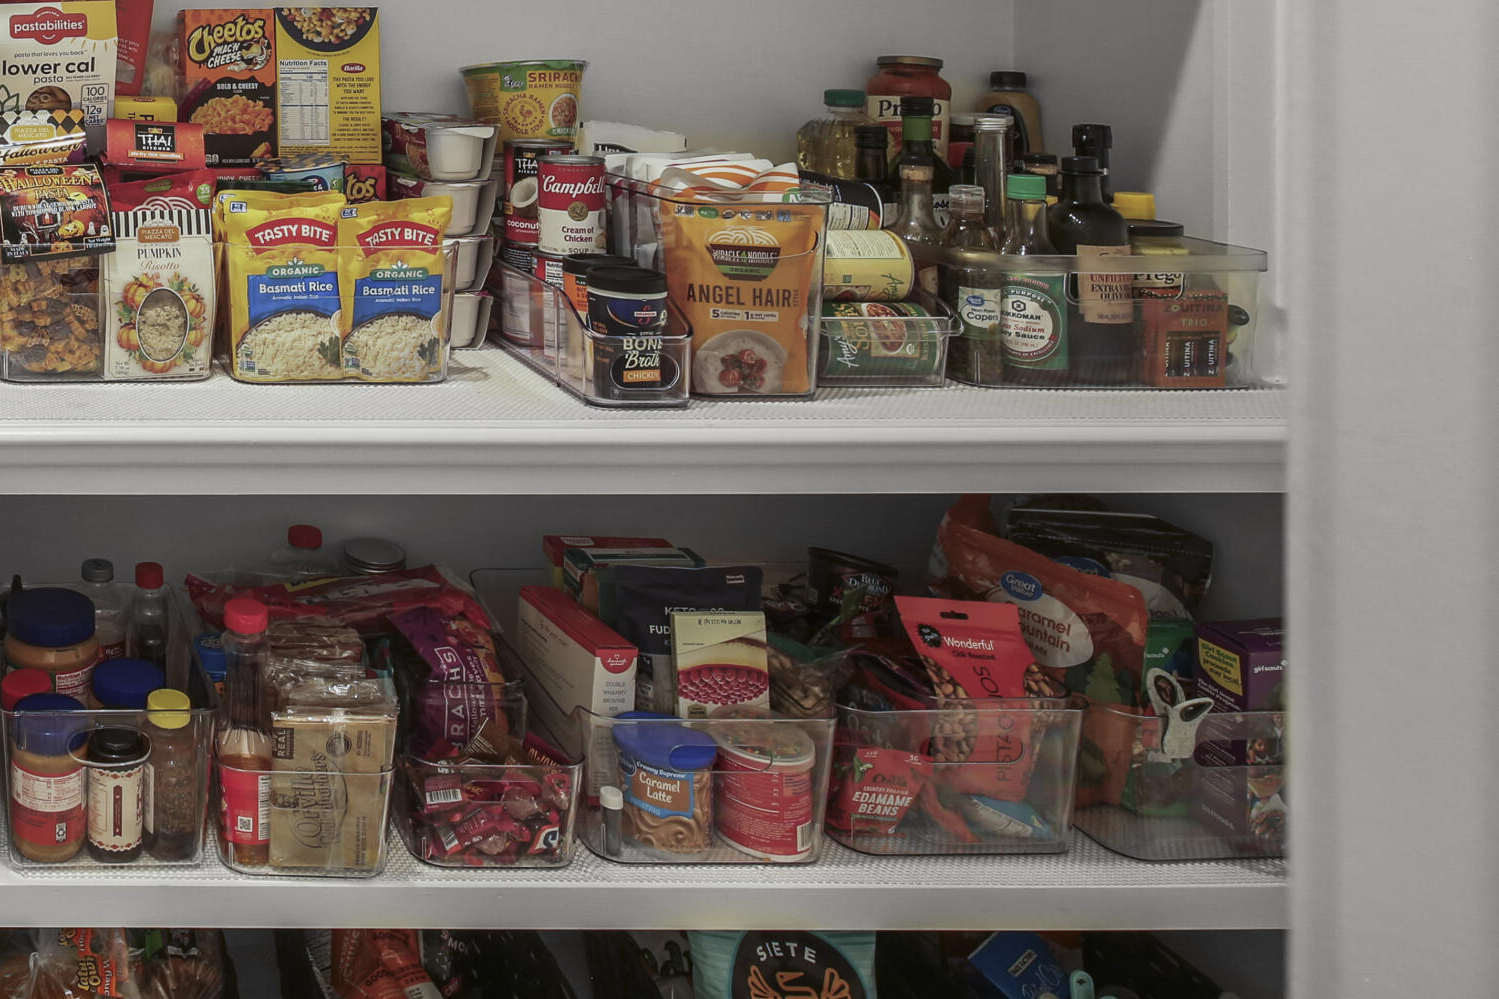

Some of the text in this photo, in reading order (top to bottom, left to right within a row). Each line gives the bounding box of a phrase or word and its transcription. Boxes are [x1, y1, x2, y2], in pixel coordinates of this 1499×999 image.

[14, 20, 83, 34] pastabilities
[189, 14, 266, 62] Cheetos
[214, 42, 239, 55] MAC'N
[2, 57, 95, 76] lower cal
[208, 52, 242, 68] CHEESE
[33, 75, 64, 85] pasta
[86, 86, 104, 96] 100
[85, 105, 102, 115] 12g
[137, 134, 172, 146] THAI
[1, 176, 93, 193] HALLOWEEN
[35, 187, 70, 200] PASTA
[254, 224, 331, 244] TASTY BITE
[561, 226, 585, 234] Cream
[365, 228, 436, 248] TASTY BITE
[564, 234, 593, 243] Chicken
[137, 248, 182, 260] PUMPKIN
[140, 261, 181, 271] Risotto
[272, 266, 320, 276] ORGANIC
[376, 270, 423, 279] ORGANIC
[259, 282, 334, 294] Basmati Rice
[362, 285, 435, 296] Basmati Rice
[686, 283, 791, 308] ANGEL HAIR
[712, 309, 719, 318] 5
[1014, 323, 1045, 333] Sodium
[1181, 318, 1208, 327] TRIO
[1015, 332, 1045, 340] Sauce
[1005, 574, 1036, 592] Great
[944, 636, 994, 650] Wonderful
[278, 730, 286, 757] REAL
[636, 761, 685, 779] Creamy Supreme
[639, 772, 680, 793] Caramel
[646, 787, 673, 804] Latte
[852, 792, 913, 807] EDAMAME
[858, 803, 899, 816] BEANS
[756, 940, 818, 965] SIETE
